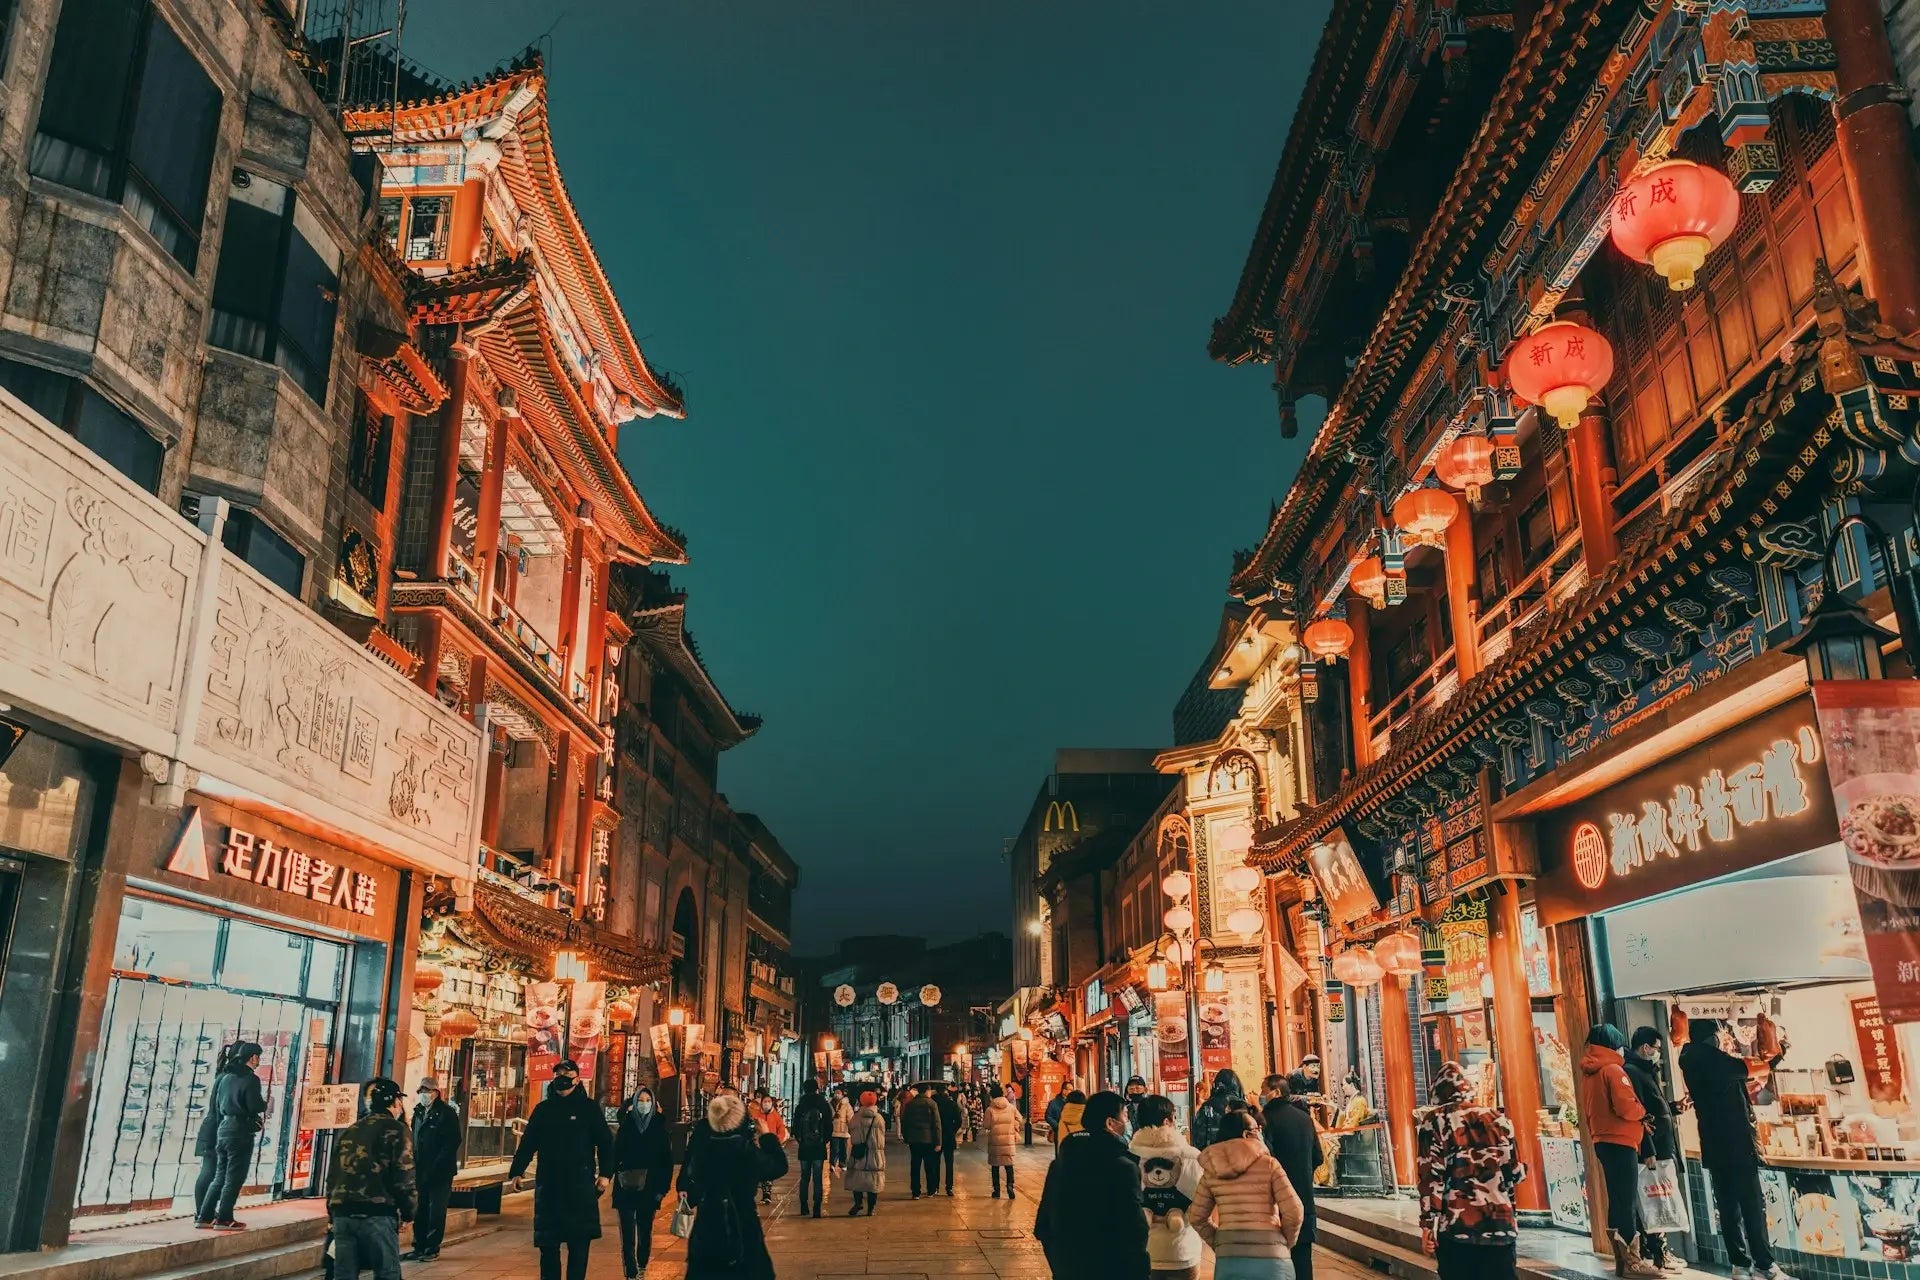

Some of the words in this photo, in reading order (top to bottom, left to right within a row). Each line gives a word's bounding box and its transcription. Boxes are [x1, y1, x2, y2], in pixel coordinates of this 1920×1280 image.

[1616, 177, 1677, 223] 新成
[1528, 335, 1587, 368] 新成
[222, 826, 378, 917] 足力健老人鞋
[1870, 1028, 1892, 1085] 销量冠军
